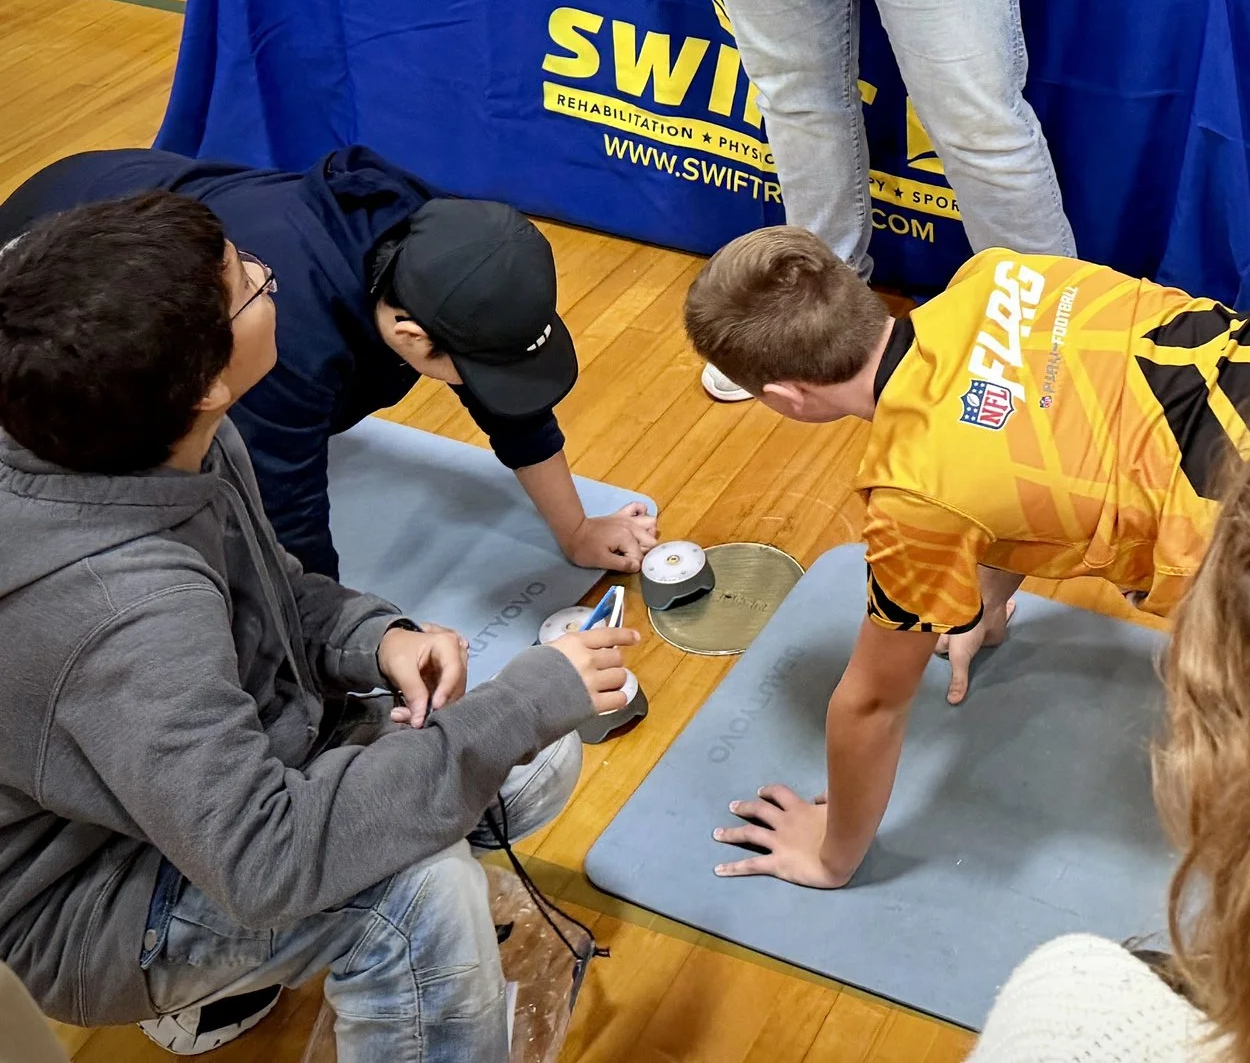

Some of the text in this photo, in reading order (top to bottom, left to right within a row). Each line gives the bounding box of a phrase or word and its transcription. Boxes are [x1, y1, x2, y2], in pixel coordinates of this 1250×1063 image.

[541, 5, 878, 129] SWI
[557, 94, 960, 212] REHABILITATION PHYSIC SPOR
[967, 260, 1046, 402] FLAG
[1051, 286, 1079, 346] FOOTBALL
[979, 387, 1008, 426] NFL
